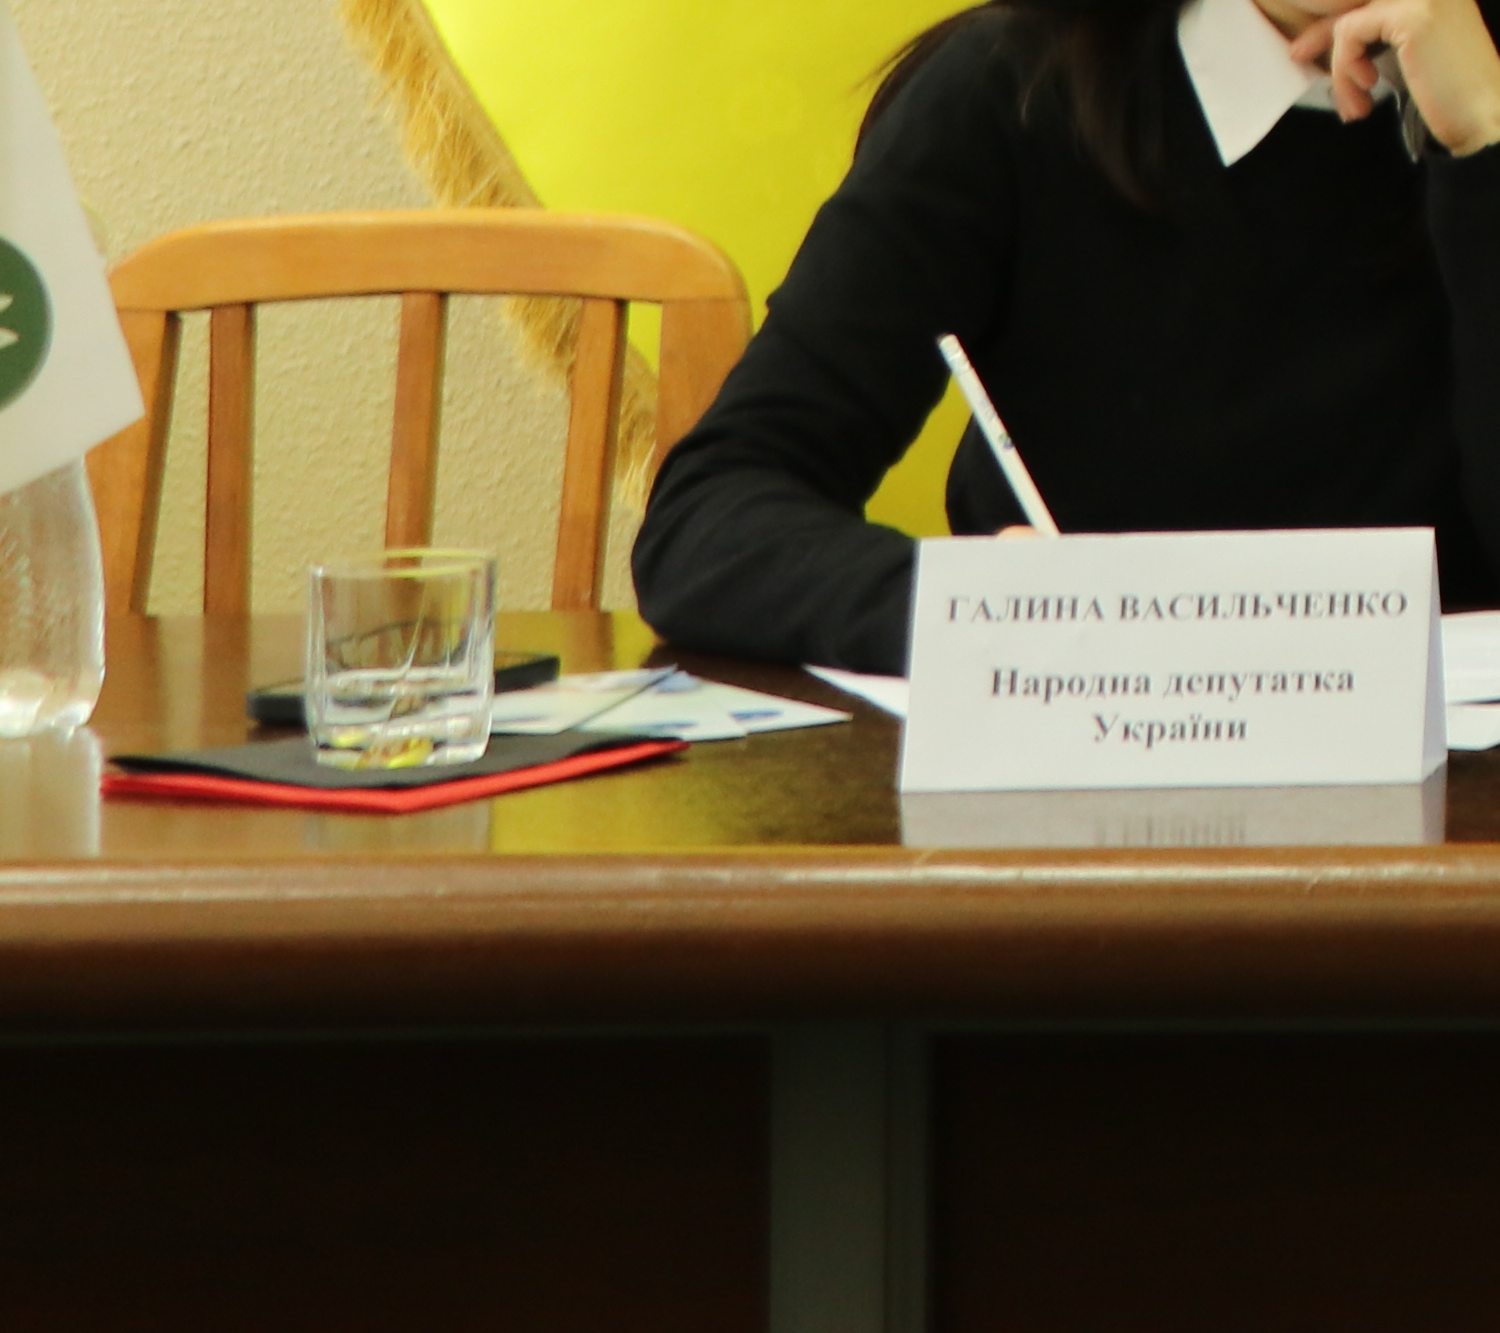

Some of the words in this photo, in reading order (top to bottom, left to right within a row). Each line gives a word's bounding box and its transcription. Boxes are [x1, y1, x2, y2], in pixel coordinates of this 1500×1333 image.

[947, 595, 1104, 623] ГАЛИНА
[1118, 591, 1409, 621] ВАСИЛЬЧЕНКО
[989, 667, 1152, 704] Народна
[1162, 670, 1355, 703] депутатка
[1092, 713, 1248, 749] України
